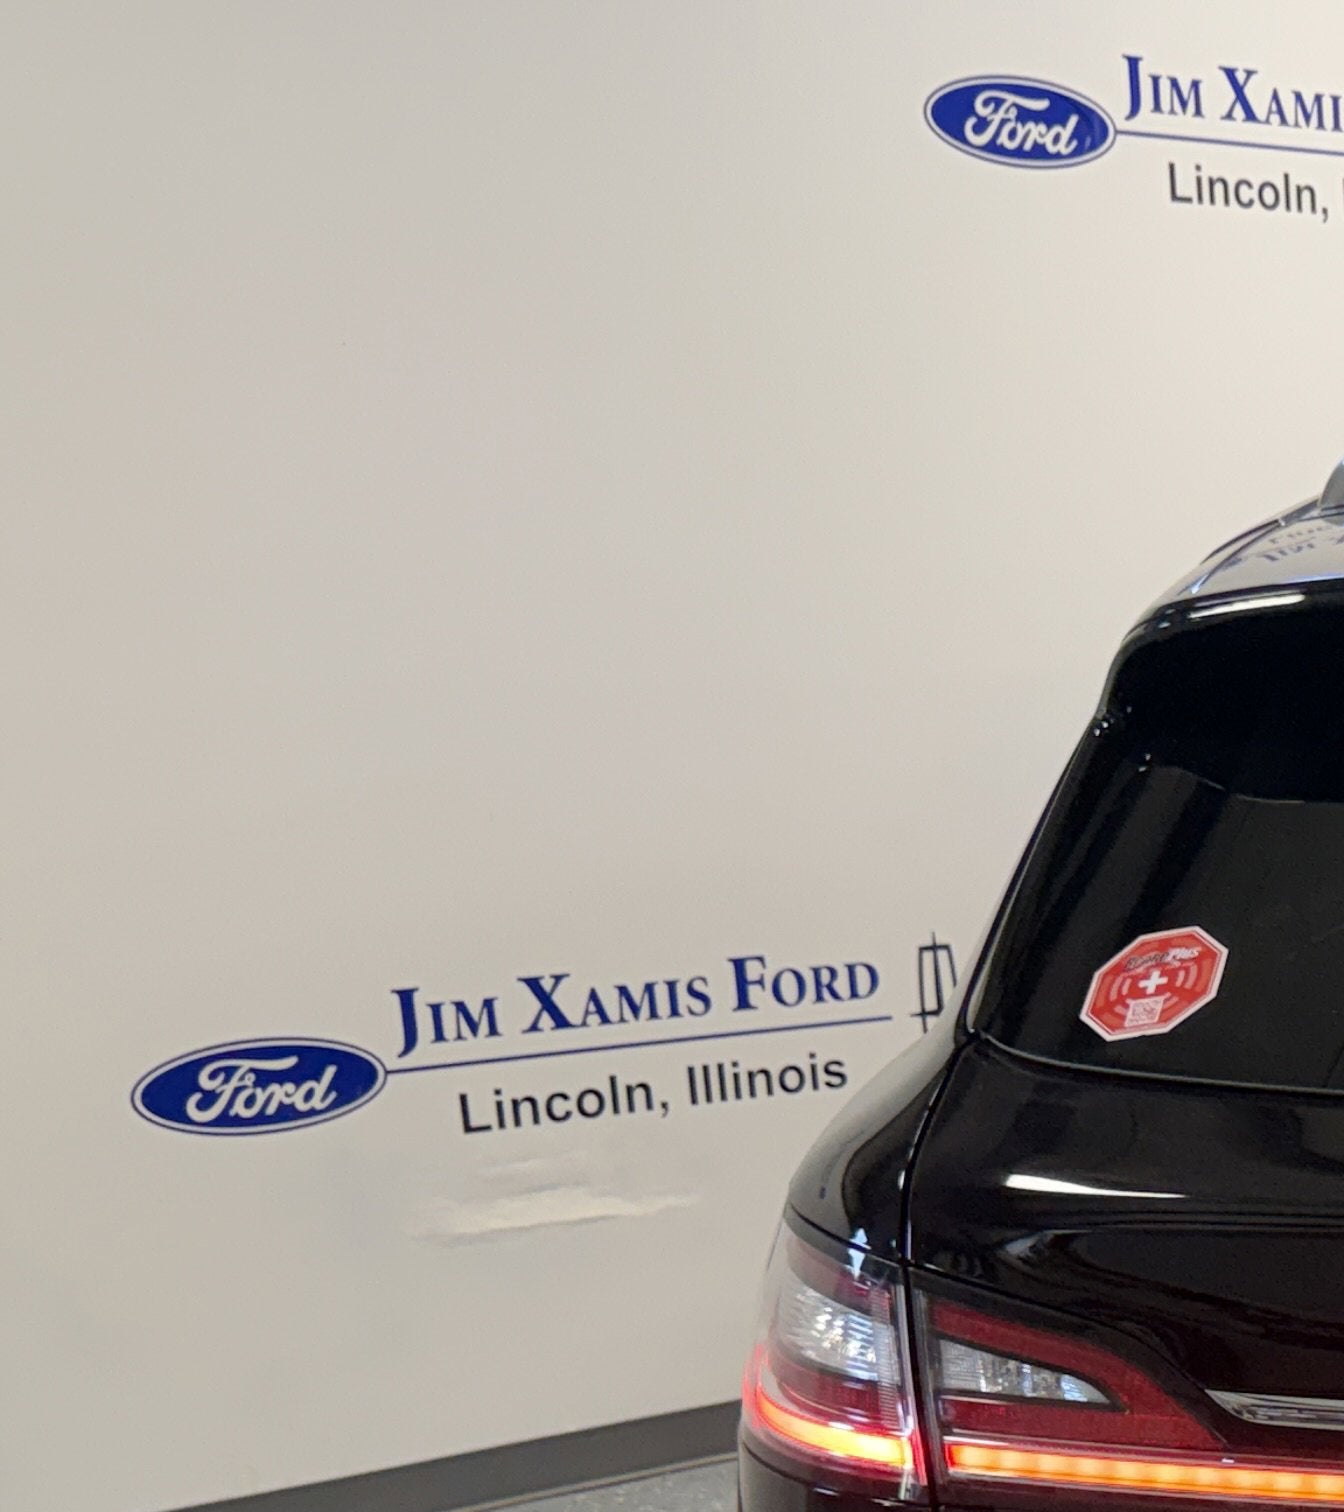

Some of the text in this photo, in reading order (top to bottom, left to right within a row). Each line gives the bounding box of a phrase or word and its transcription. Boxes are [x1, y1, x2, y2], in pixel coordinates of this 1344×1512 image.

[1122, 54, 1202, 121] JIM
[963, 89, 1078, 155] Ford
[1167, 162, 1329, 221] Lincoln,
[390, 954, 881, 1058] JIM XAMIS FORD
[186, 1056, 337, 1122] Ford
[458, 1053, 849, 1134] Lincoln, Illinois
